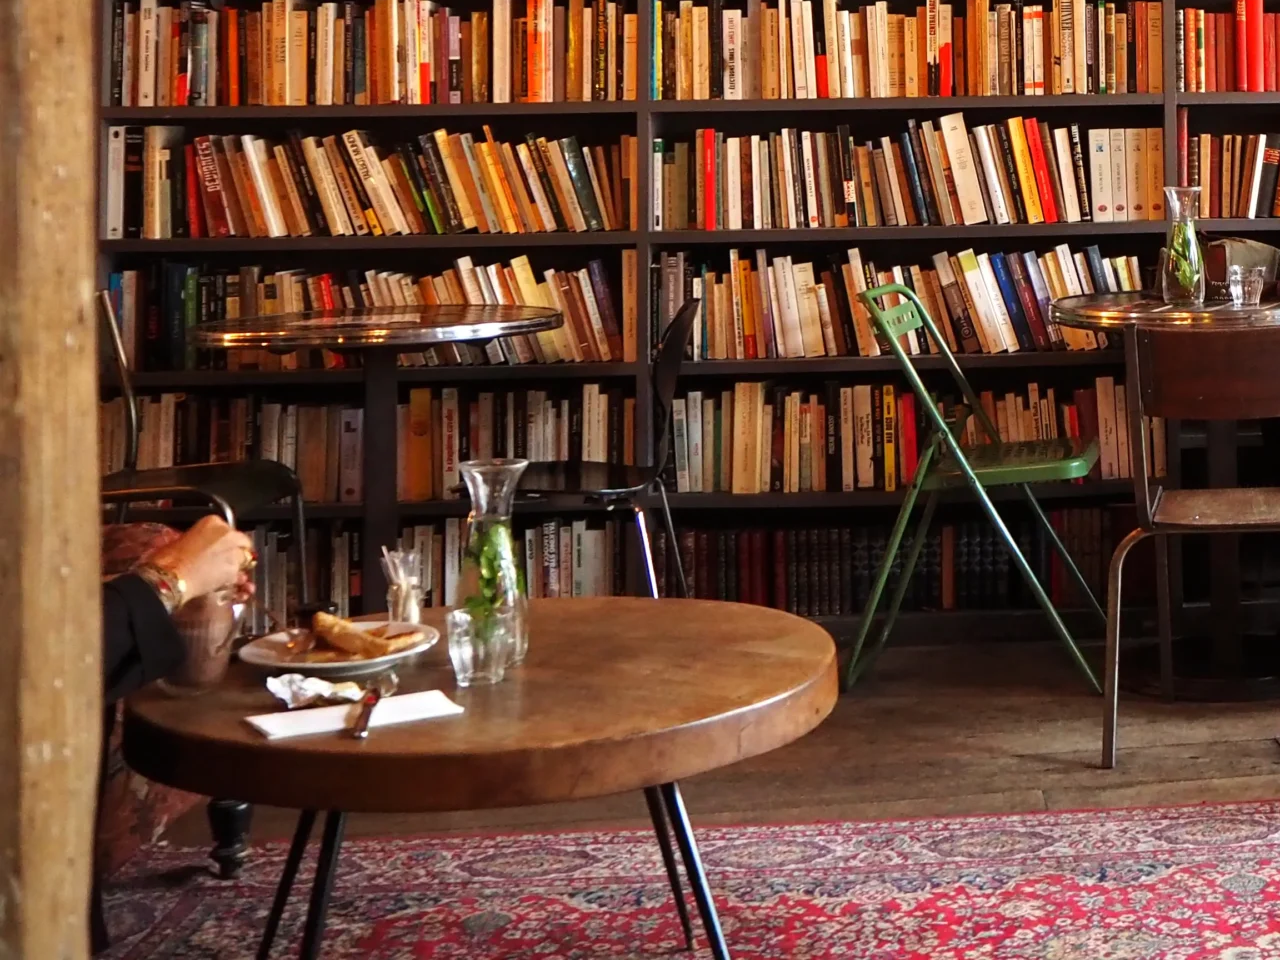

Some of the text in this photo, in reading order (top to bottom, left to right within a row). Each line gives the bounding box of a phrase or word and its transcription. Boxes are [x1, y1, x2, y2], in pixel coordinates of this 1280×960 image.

[928, 13, 937, 35] CENTRAL
[1060, 1, 1072, 32] THINNER
[728, 47, 736, 64] LIBRES
[201, 141, 221, 192] DEVIANCES
[347, 133, 371, 181] TALBOT MUNDY
[885, 417, 893, 444] MAD DOGS
[548, 522, 556, 590] TALKING STRAIGHT
